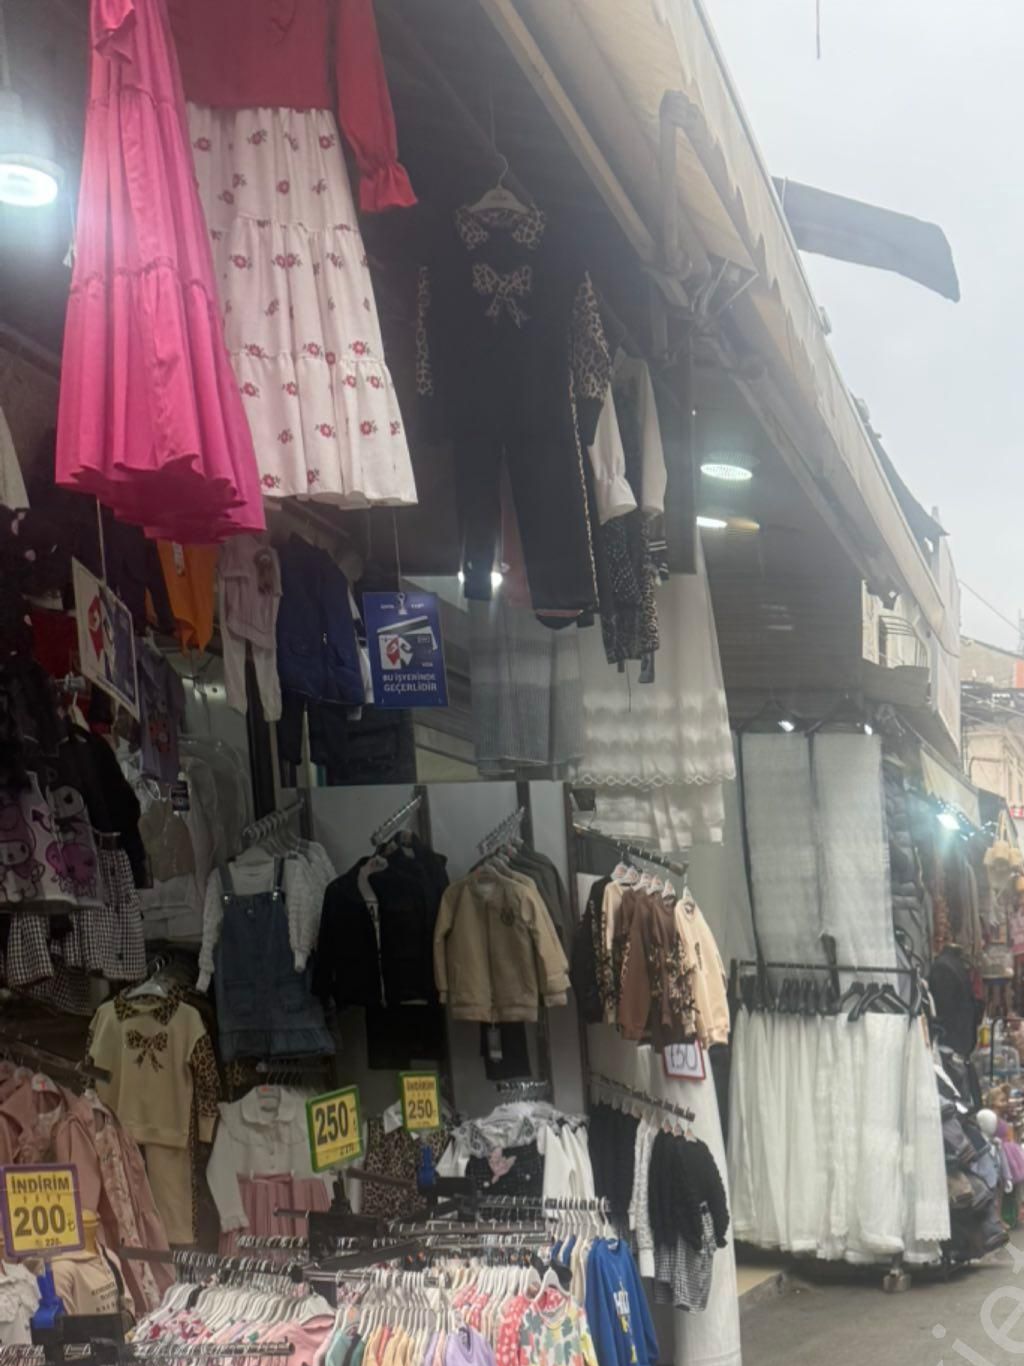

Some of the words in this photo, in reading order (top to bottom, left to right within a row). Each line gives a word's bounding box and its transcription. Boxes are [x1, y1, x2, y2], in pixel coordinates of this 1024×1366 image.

[384, 681, 438, 694] GEÇERLİDİR
[394, 672, 436, 683] İŞYERİNDE
[408, 1099, 433, 1119] 250
[315, 1101, 349, 1146] 250
[11, 1174, 70, 1195] İNDİRİM
